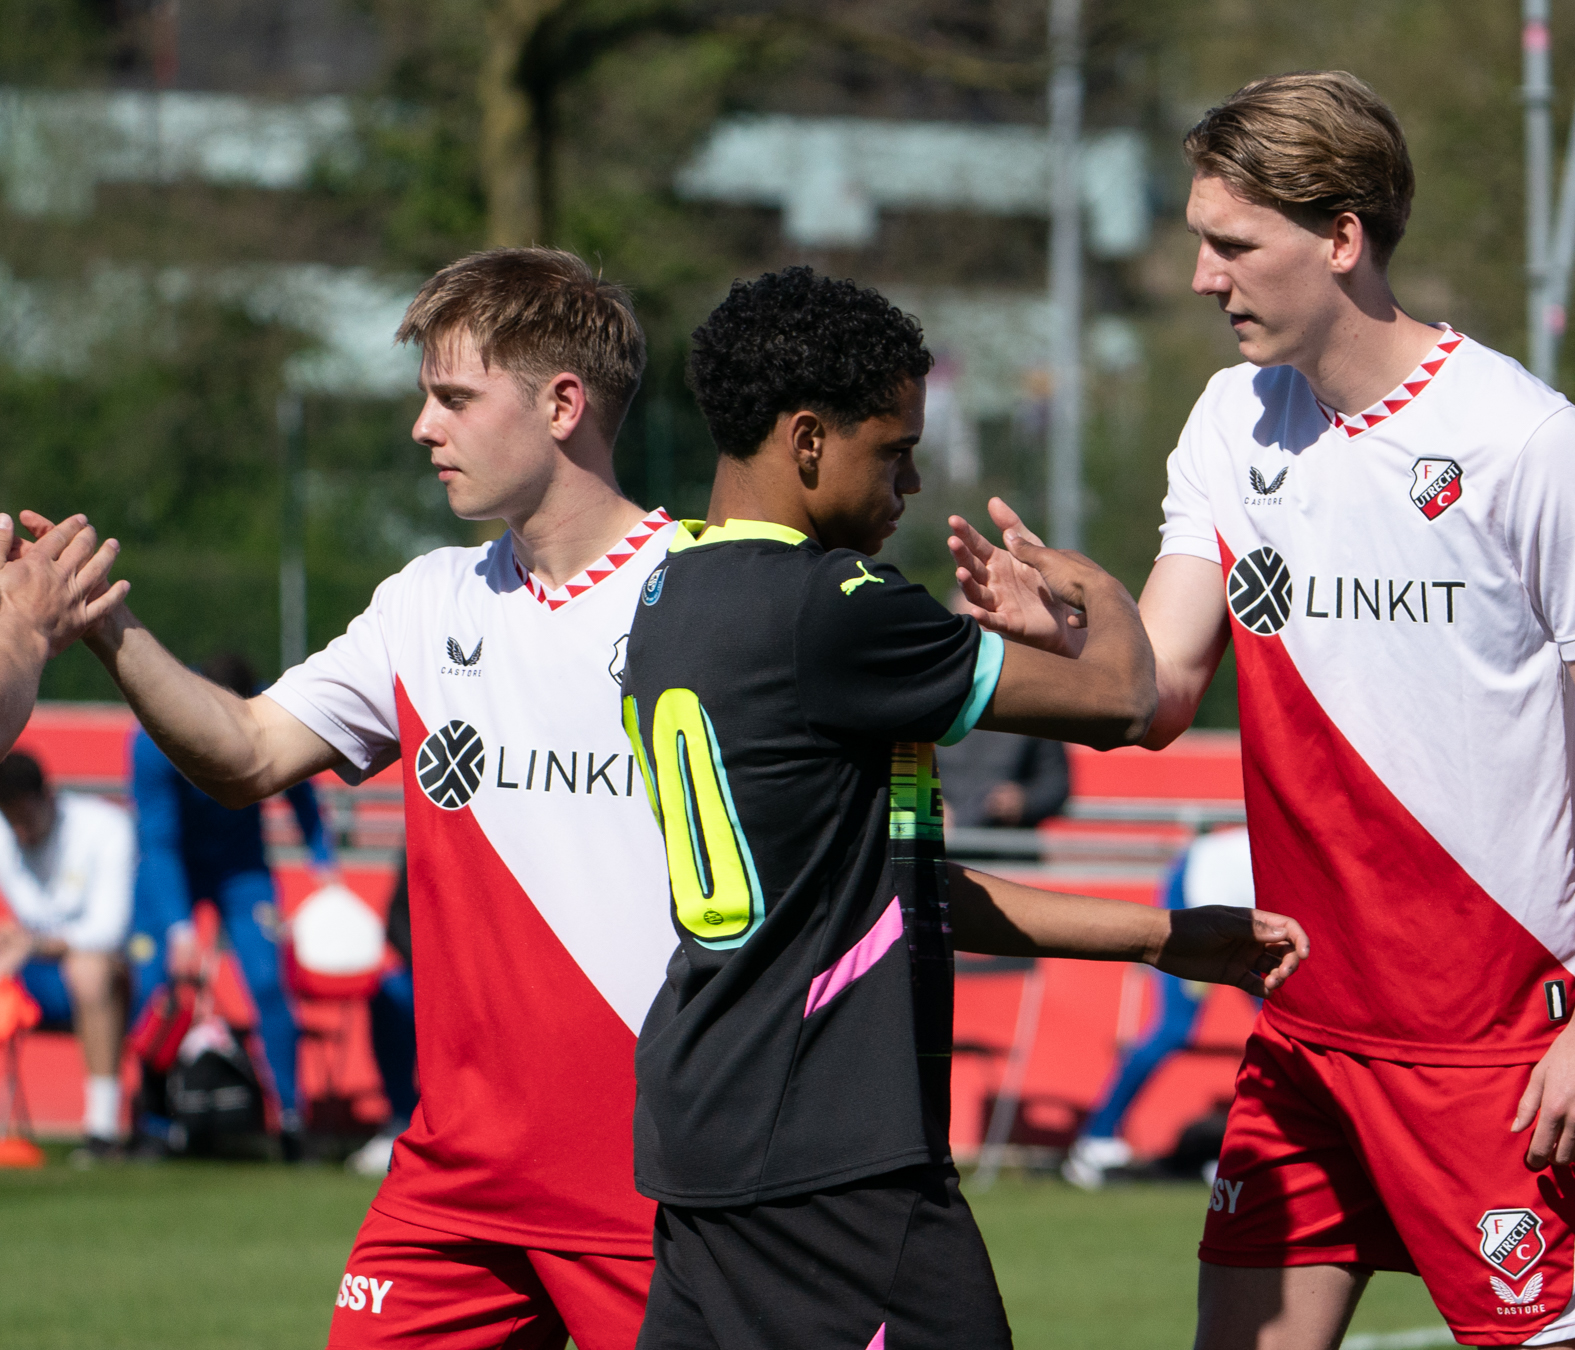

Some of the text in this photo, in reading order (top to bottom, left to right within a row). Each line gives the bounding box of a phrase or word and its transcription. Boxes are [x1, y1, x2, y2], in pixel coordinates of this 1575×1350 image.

[1424, 464, 1433, 480] F
[1414, 463, 1460, 509] UTRECHT
[1244, 496, 1283, 506] CASTORE
[1437, 491, 1452, 507] C
[1306, 575, 1466, 624] LINKIT
[441, 666, 482, 677] CASTORE
[496, 746, 634, 797] LINKI
[1209, 1177, 1244, 1214] SY
[1494, 1219, 1503, 1234] F
[1490, 1214, 1536, 1264] UTRECHT
[1516, 1243, 1531, 1260] C
[1496, 1303, 1546, 1315] CASTORE
